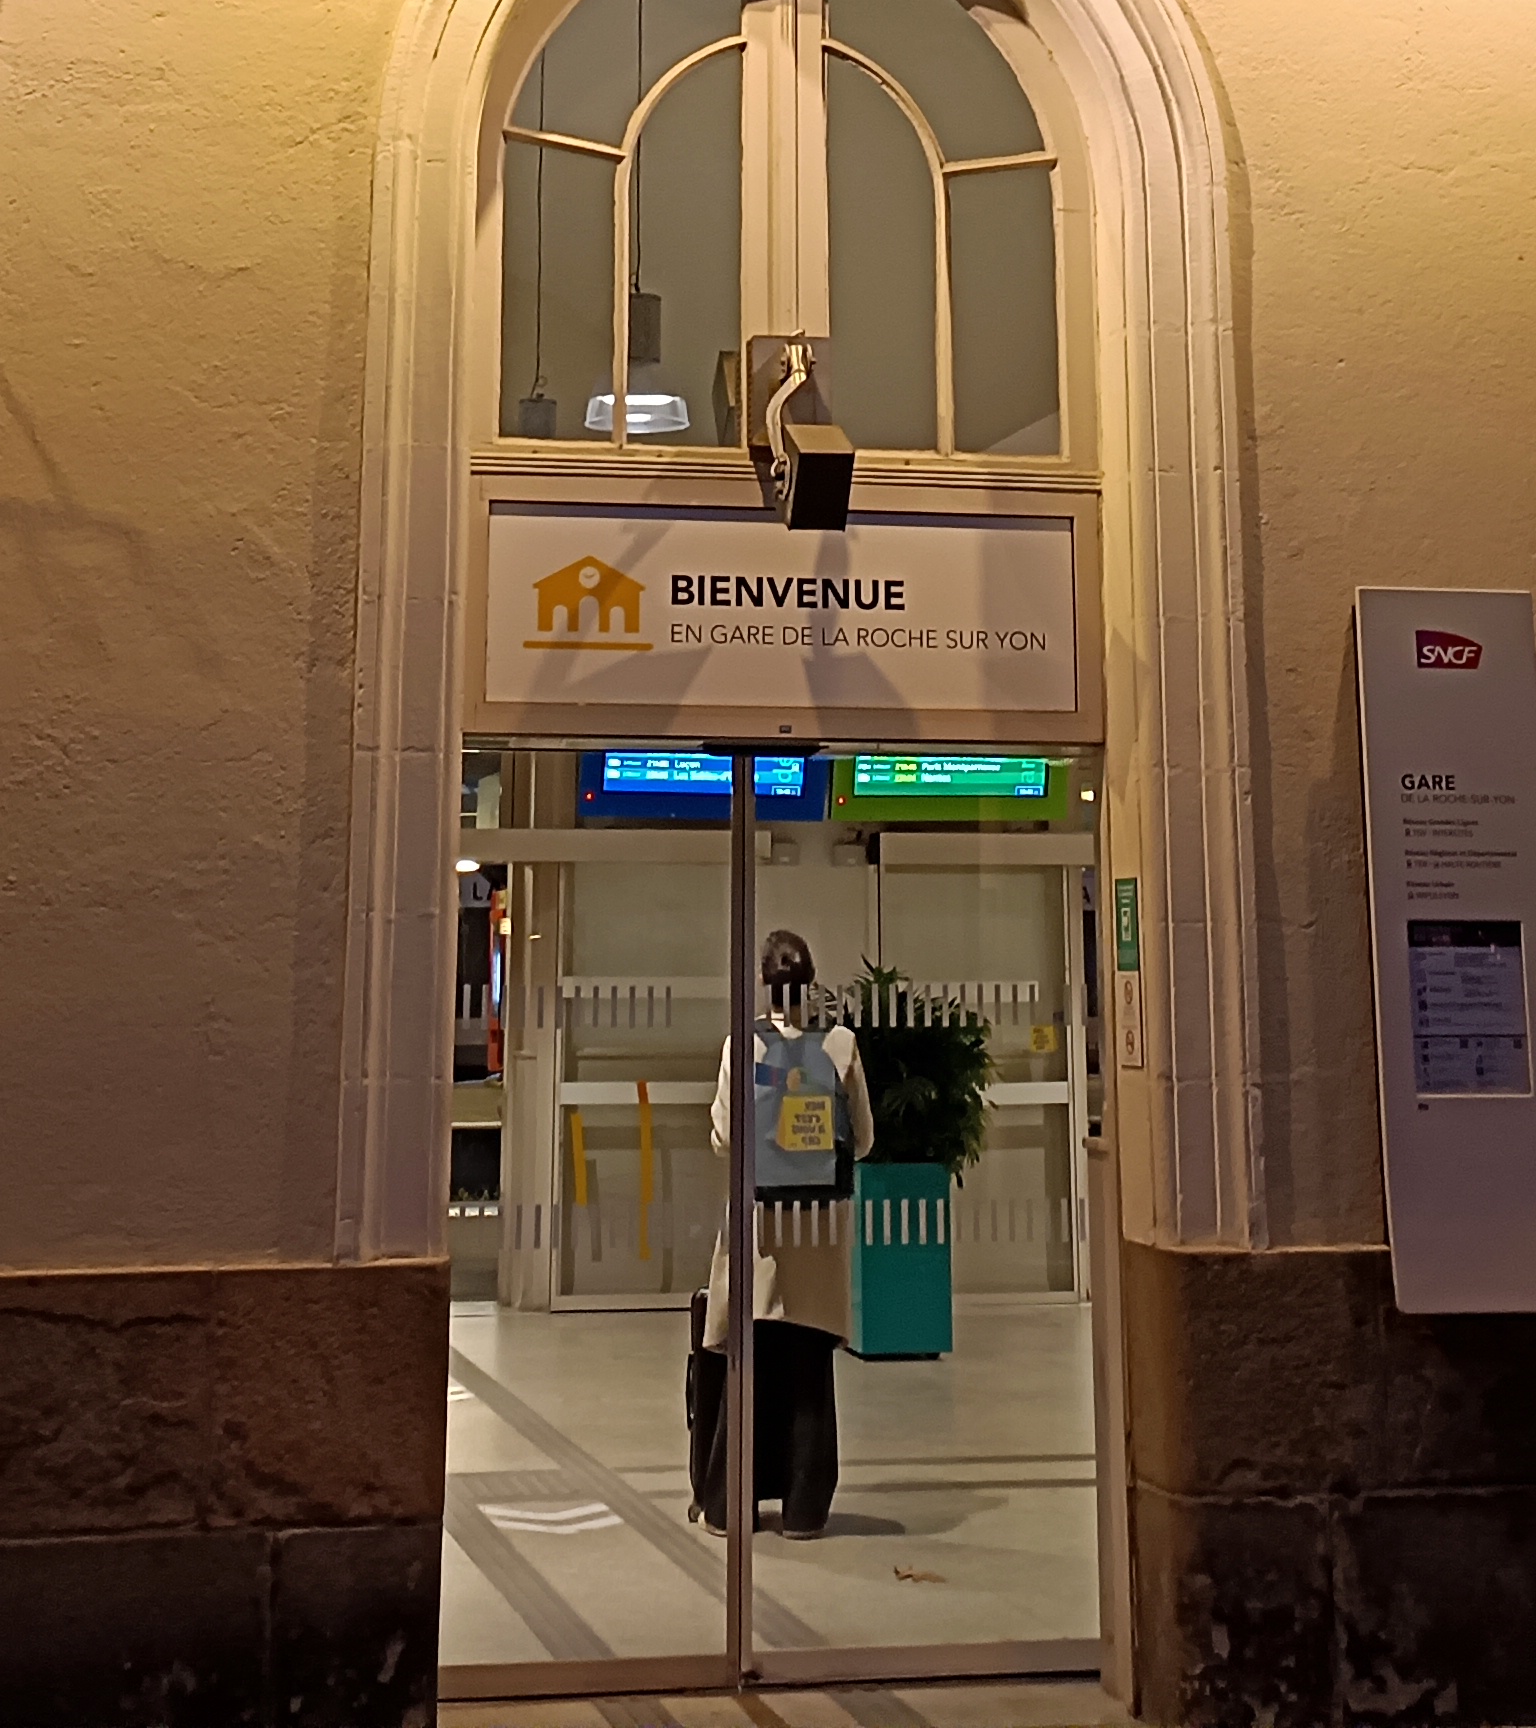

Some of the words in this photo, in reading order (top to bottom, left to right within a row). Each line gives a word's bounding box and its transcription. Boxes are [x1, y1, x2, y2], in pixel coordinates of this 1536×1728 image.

[670, 574, 906, 611] BIENVENUE
[670, 624, 703, 644] EN
[710, 624, 775, 646] GARE
[782, 626, 813, 646] DE
[822, 627, 850, 647] LA
[856, 628, 939, 649] ROCHE
[946, 630, 989, 651] SUR
[995, 631, 1047, 651] YON
[1420, 645, 1478, 664] SNCF
[1401, 773, 1456, 791] GARE
